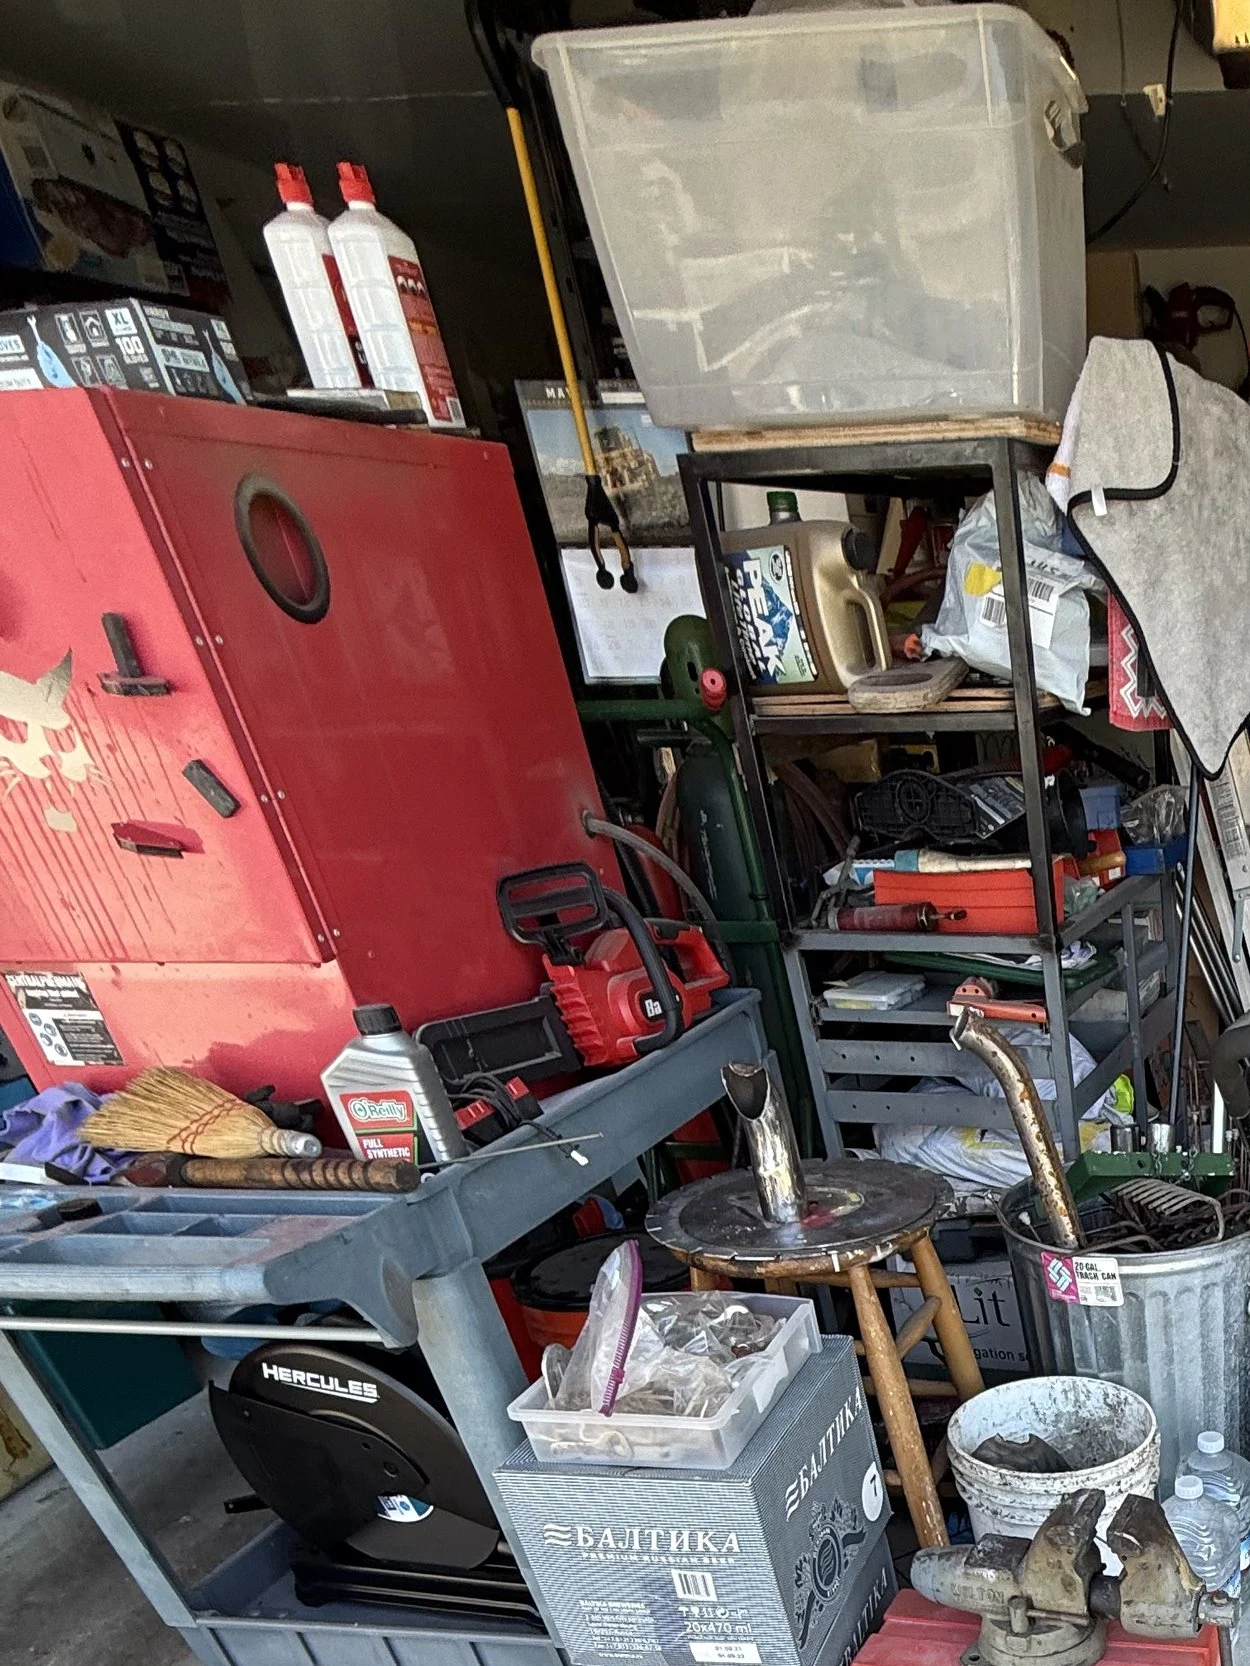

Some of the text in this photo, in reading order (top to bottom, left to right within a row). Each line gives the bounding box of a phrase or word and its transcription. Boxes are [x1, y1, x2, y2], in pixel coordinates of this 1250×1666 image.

[113, 311, 130, 326] XL
[116, 336, 144, 356] 100
[743, 557, 787, 678] PEAK
[644, 998, 664, 1018] Ba
[351, 1098, 405, 1119] O'Reilly
[362, 1138, 383, 1149] FULL
[366, 1147, 411, 1159] SYNTHETIC
[1074, 1261, 1083, 1271] 20
[1076, 1271, 1117, 1280] TRASH CAN
[262, 1362, 379, 1398] HERCULES
[799, 1386, 863, 1500] БАЛТИКА
[869, 1473, 879, 1498] 7
[575, 1526, 741, 1553] БАЛТИКА
[582, 1552, 736, 1565] PREMIUM RUSSIAN BEER
[685, 1621, 752, 1634] 20x470 ml
